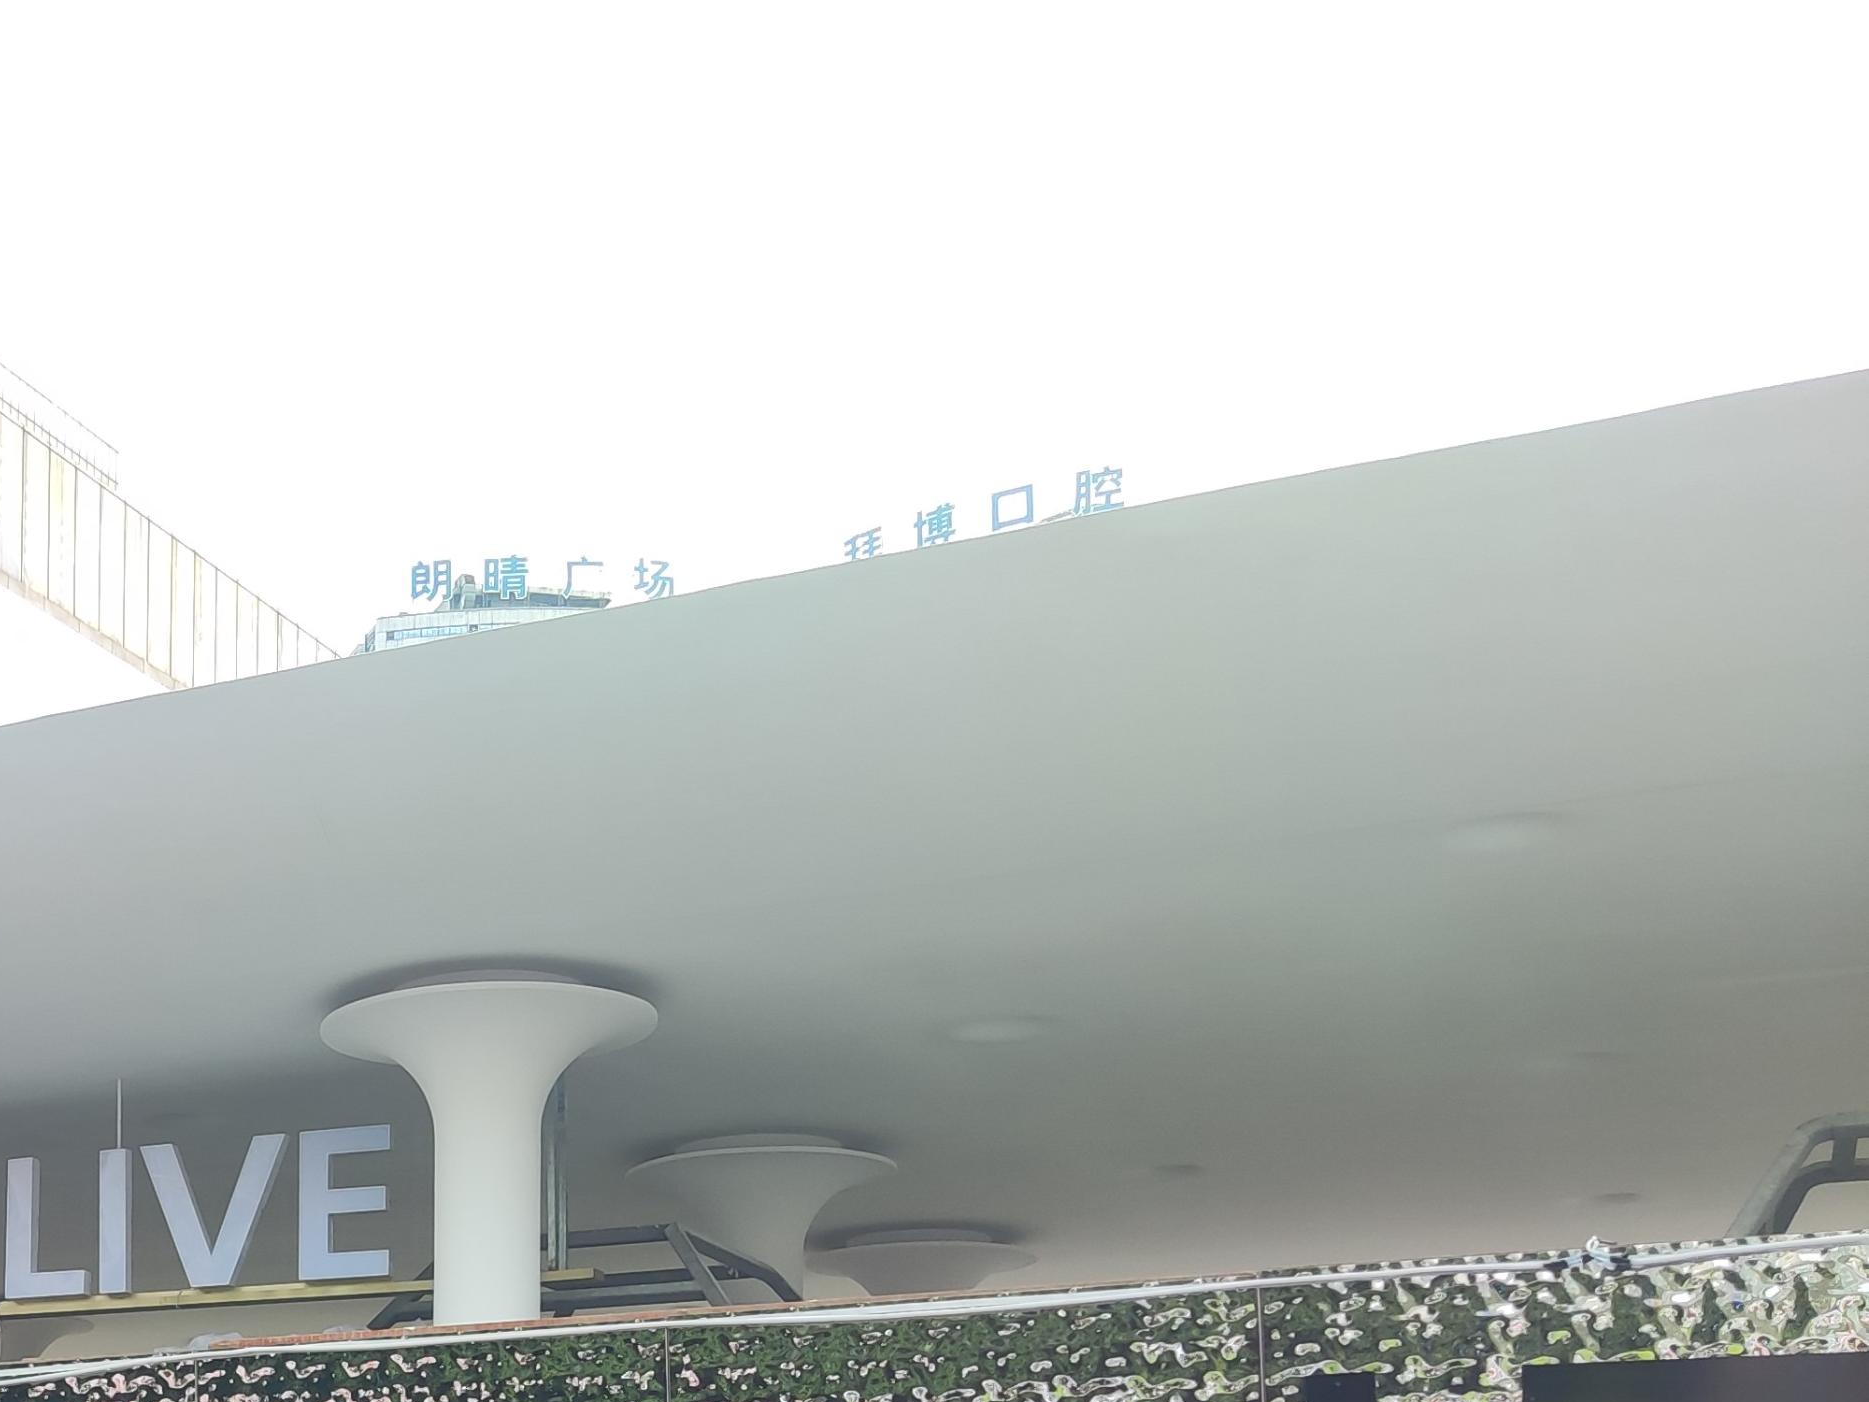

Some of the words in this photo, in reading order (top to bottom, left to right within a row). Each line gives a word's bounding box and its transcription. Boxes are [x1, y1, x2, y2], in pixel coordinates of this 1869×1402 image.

[844, 466, 1124, 560] 拜博口腔
[410, 555, 675, 601] 朗晴广场
